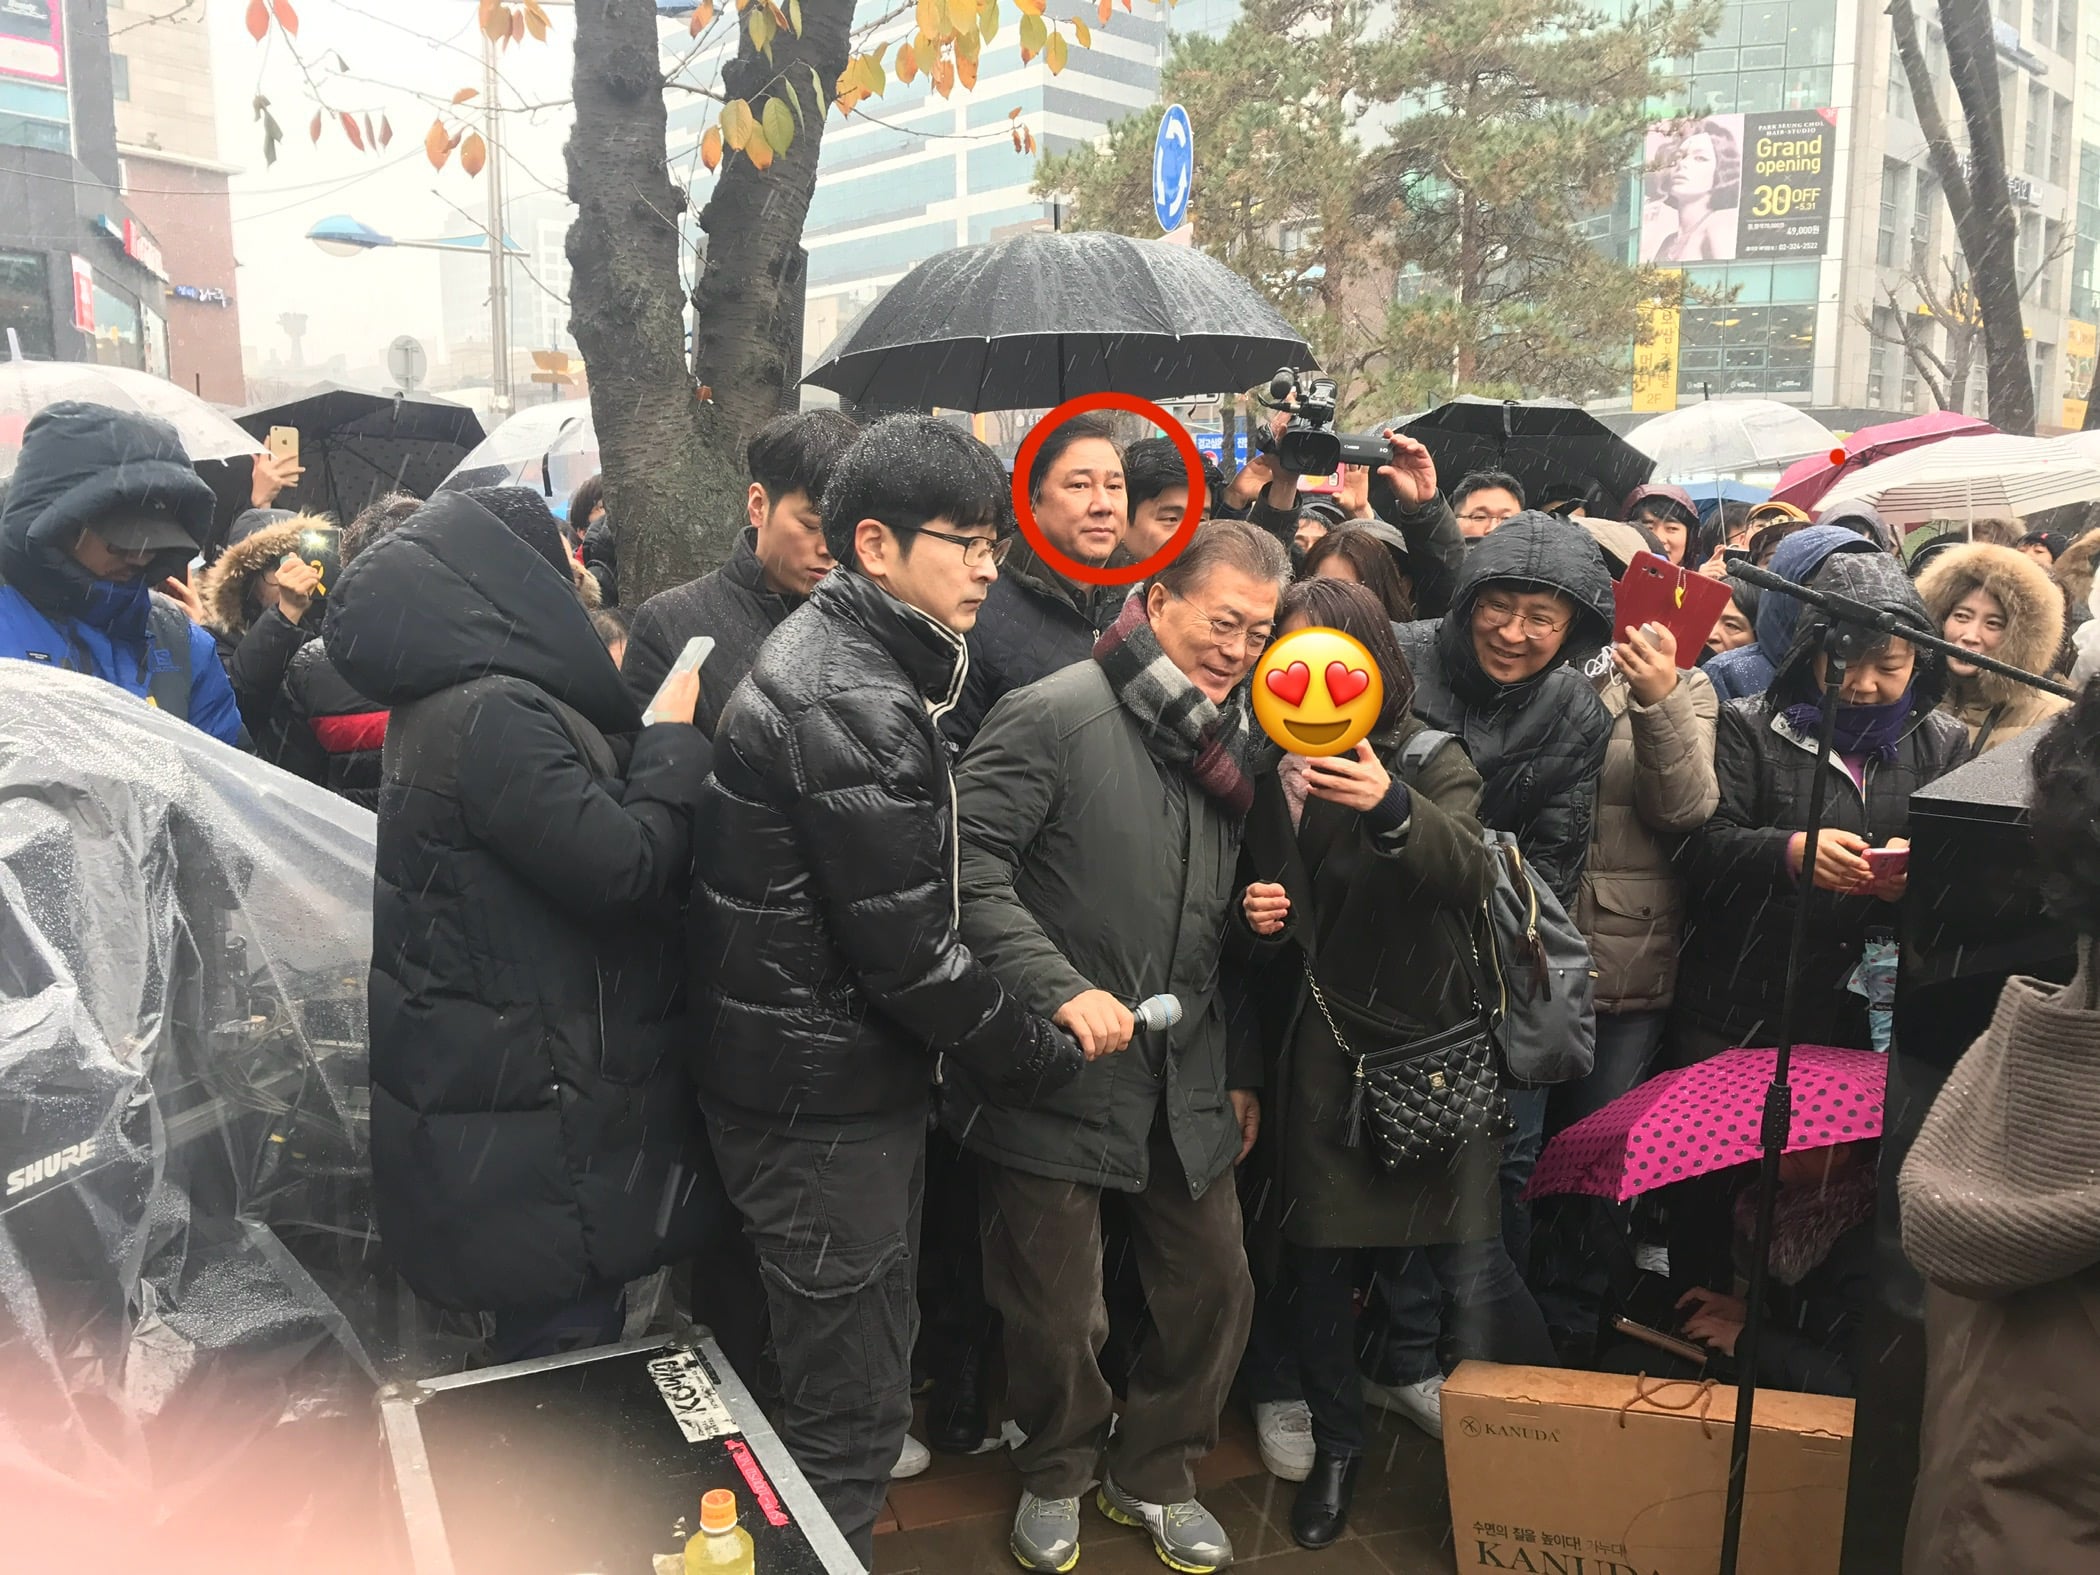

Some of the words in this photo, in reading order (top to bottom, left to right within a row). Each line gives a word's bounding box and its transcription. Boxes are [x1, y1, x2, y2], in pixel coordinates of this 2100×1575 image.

[1757, 134, 1821, 157] Grand
[1756, 155, 1821, 176] opening
[1792, 188, 1821, 202] OFF
[6, 1137, 97, 1196] SHURE
[1485, 1423, 1560, 1443] KANUDA
[1472, 1520, 1508, 1538] 수면의
[1513, 1527, 1537, 1543] 질을
[1541, 1531, 1581, 1551] 높이다!
[1475, 1540, 1662, 1575] KANUD
